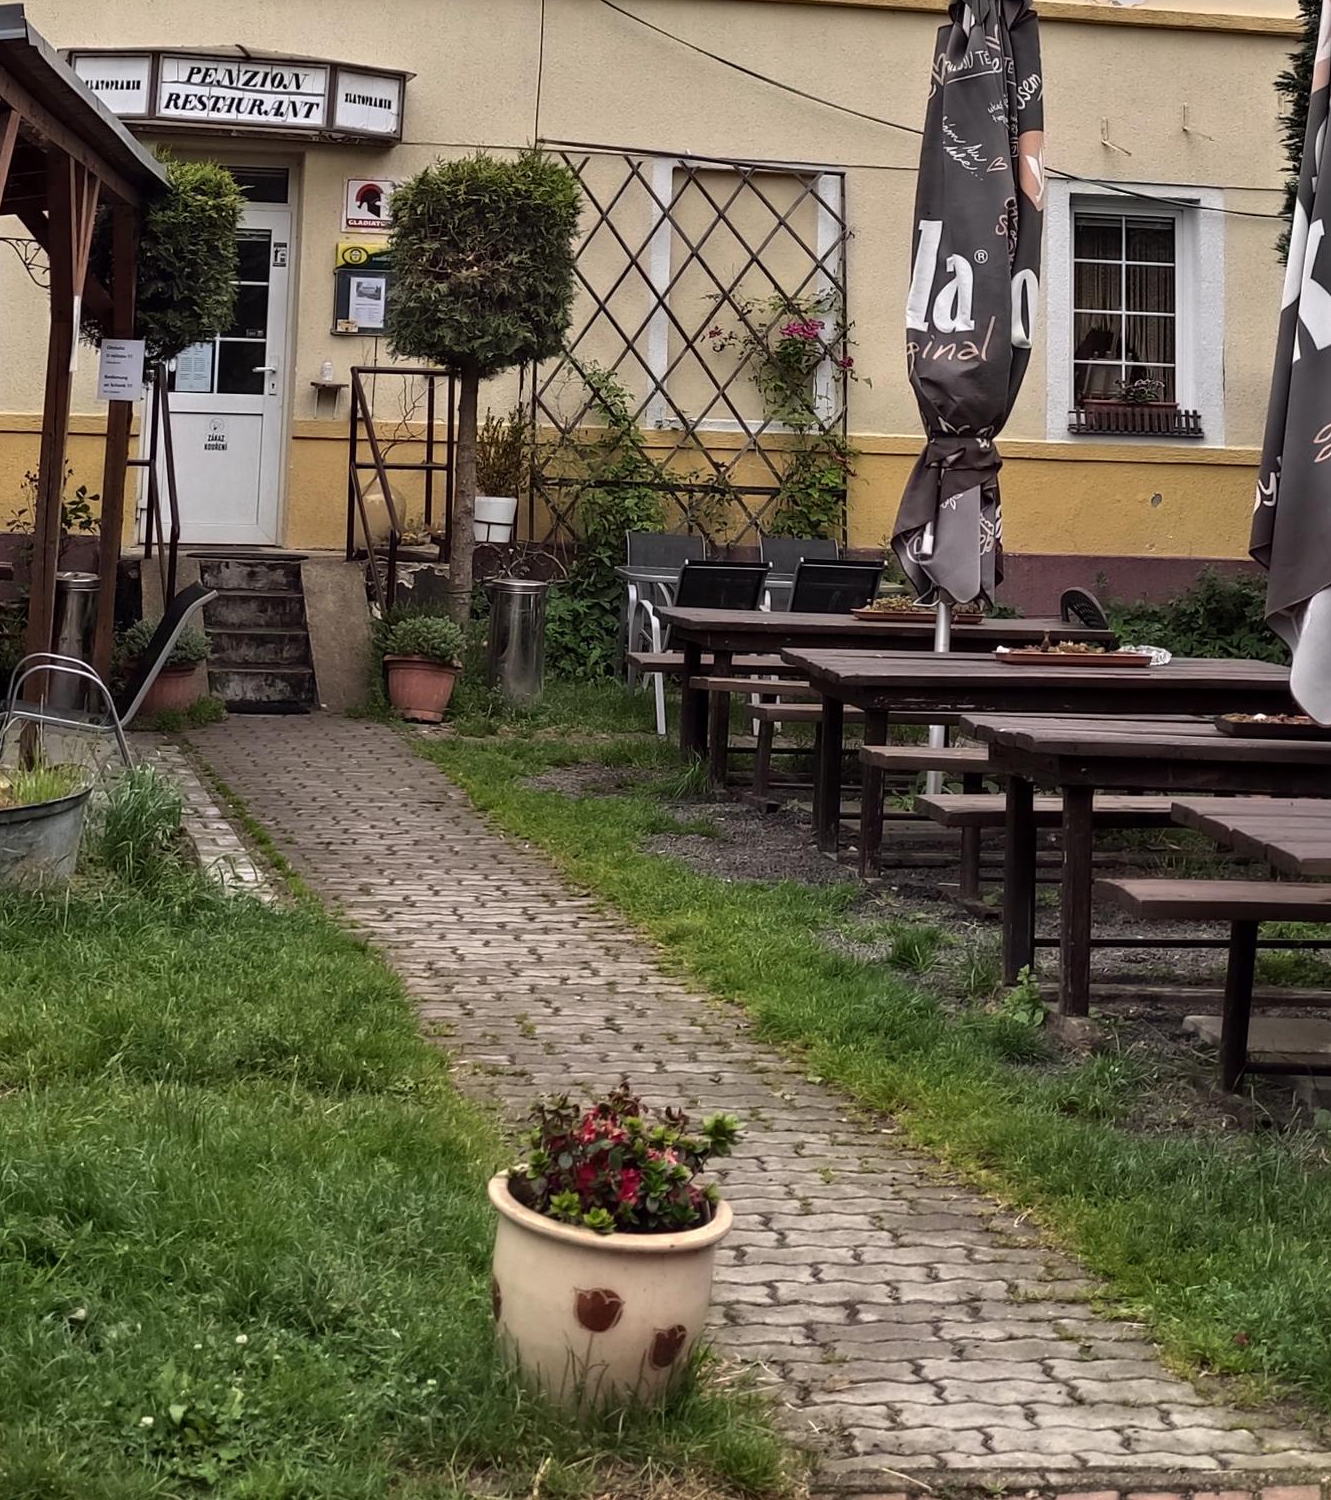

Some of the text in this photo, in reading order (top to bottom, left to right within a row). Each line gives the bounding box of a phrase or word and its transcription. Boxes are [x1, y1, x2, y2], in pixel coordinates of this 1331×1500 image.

[185, 66, 310, 91] PENZION
[164, 92, 320, 119] RESTAURANT
[348, 219, 391, 228] GLADIAT
